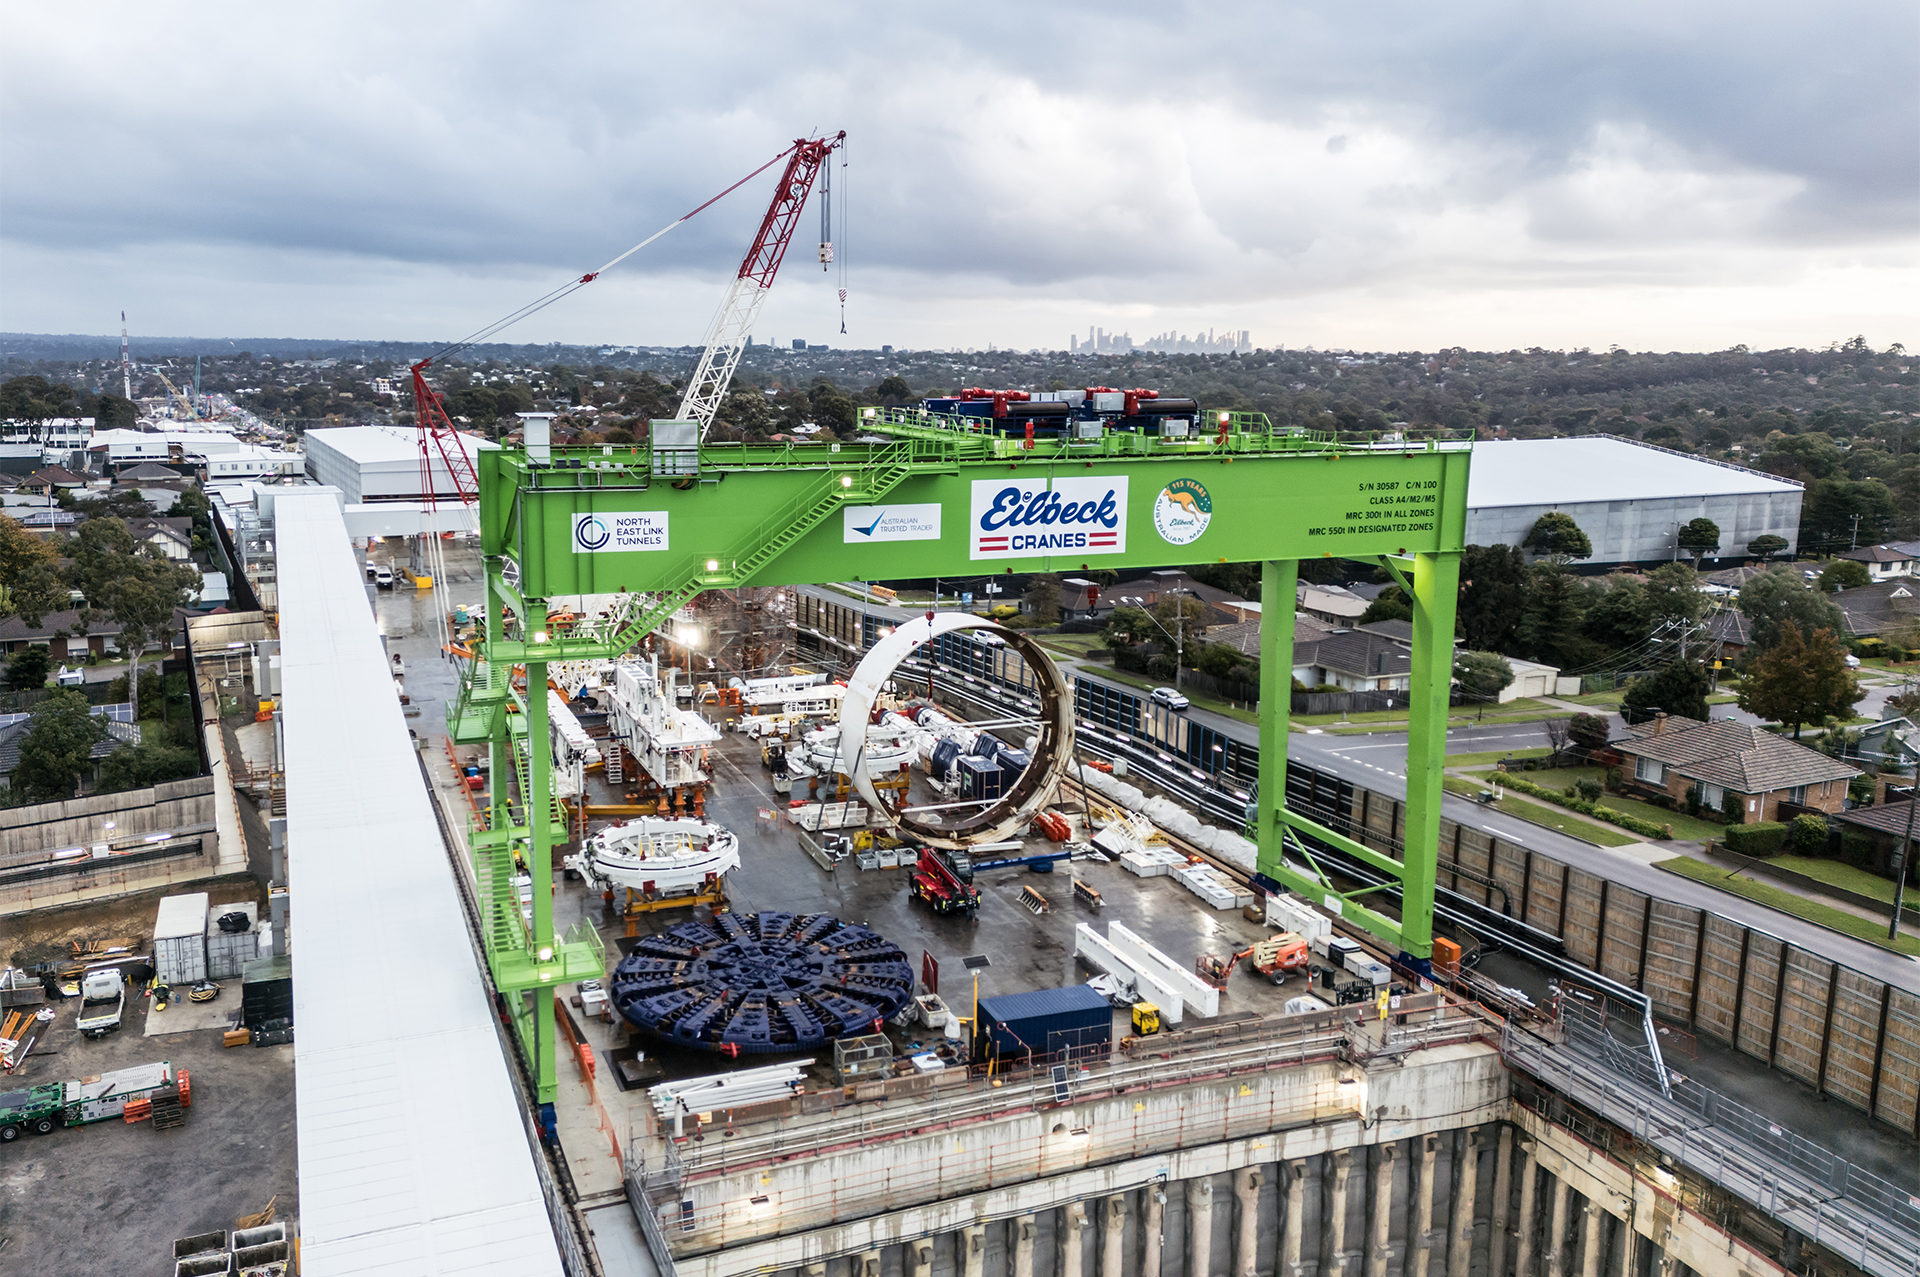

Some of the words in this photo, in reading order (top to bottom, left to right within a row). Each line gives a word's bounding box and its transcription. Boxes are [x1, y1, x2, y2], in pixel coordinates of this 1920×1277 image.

[1172, 480, 1184, 489] 115
[1186, 480, 1207, 497] YEARS
[1359, 483, 1374, 491] S/N
[1376, 482, 1400, 491] 30587
[1405, 481, 1421, 489] C/N
[1423, 480, 1437, 489] 100
[1369, 496, 1394, 505] CLASS
[1395, 495, 1436, 504] A4/M2/M5
[980, 487, 1118, 532] Eilbeck
[1345, 511, 1363, 520] MRC
[1365, 511, 1382, 519] 300t
[1383, 510, 1392, 518] IN
[1394, 510, 1407, 518] ALL
[1409, 509, 1435, 517] ZONES
[616, 518, 651, 526] NORTH
[880, 517, 918, 525] AUSTRALIAN
[1155, 498, 1184, 543] AUSTRALIAN
[616, 528, 641, 536] EAST
[643, 527, 664, 535] LINK
[880, 525, 908, 533] TRUSTED
[910, 524, 934, 532] TRADER
[1189, 517, 1208, 540] MADE
[1308, 527, 1326, 536] MRC
[1328, 527, 1346, 535] 550t
[1347, 526, 1356, 534] IN
[1358, 523, 1407, 533] DESIGNATED
[1408, 522, 1434, 531] ZONES
[616, 537, 662, 545] TUNNELS
[1011, 533, 1086, 550] CRANES
